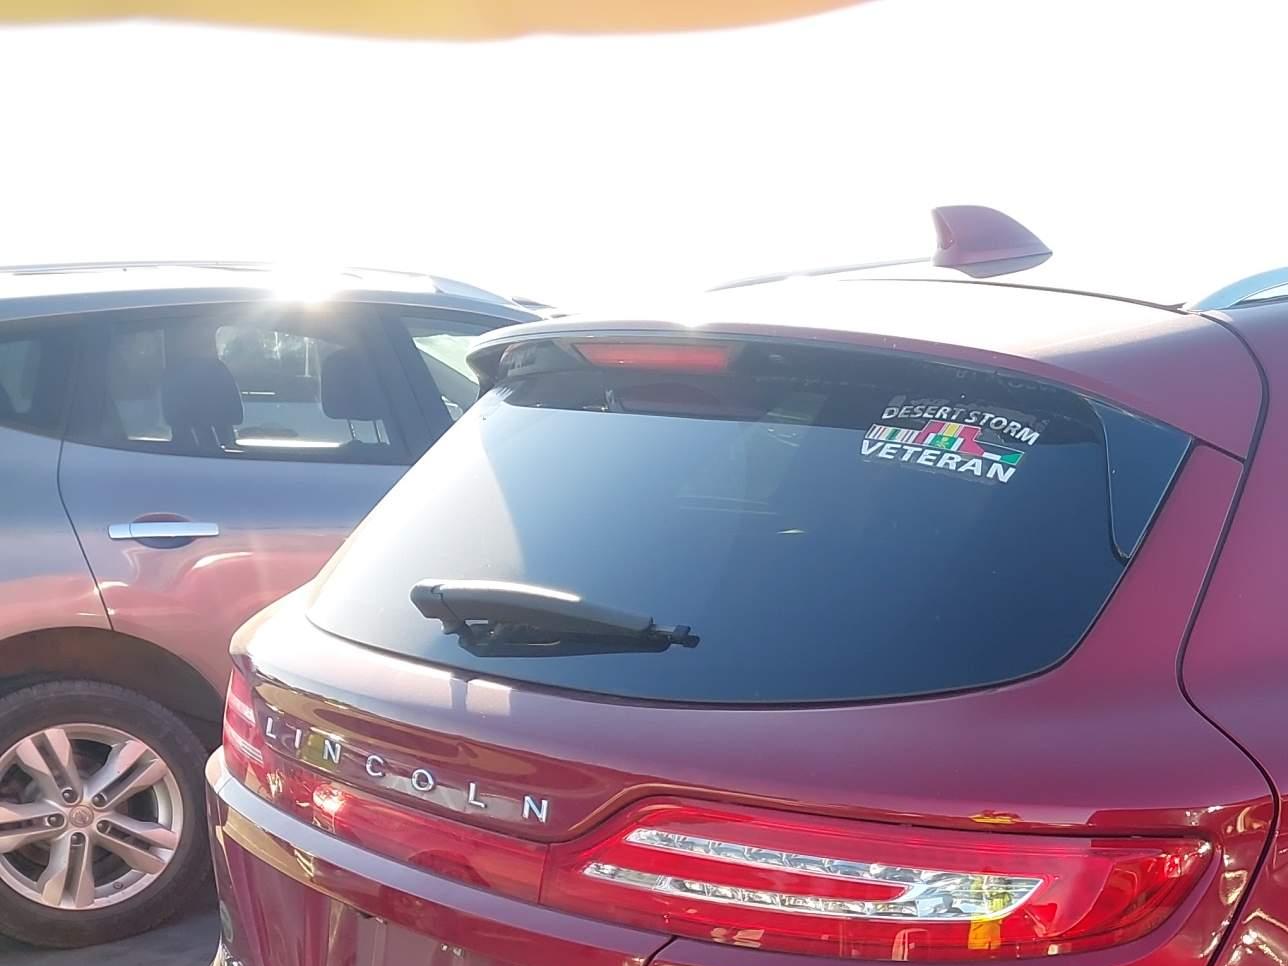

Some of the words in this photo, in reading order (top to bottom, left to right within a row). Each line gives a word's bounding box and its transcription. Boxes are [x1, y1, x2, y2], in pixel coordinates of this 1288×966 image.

[881, 405, 966, 420] DESERT
[964, 409, 1041, 446] STORM
[860, 439, 1017, 483] VETERAN
[265, 716, 549, 824] LINCOLN
